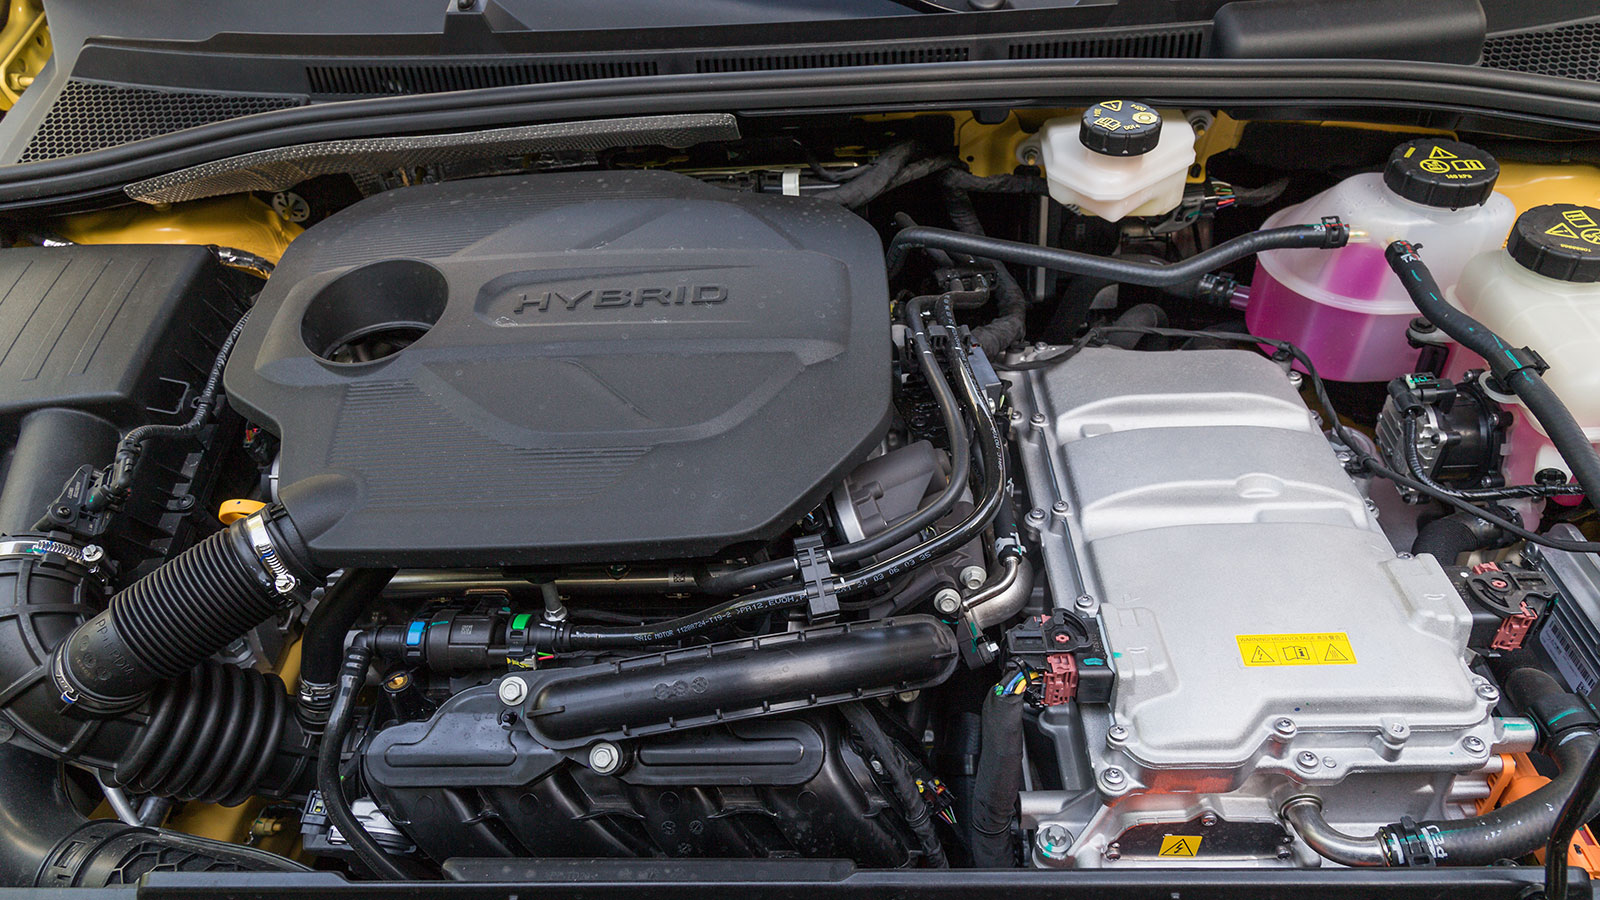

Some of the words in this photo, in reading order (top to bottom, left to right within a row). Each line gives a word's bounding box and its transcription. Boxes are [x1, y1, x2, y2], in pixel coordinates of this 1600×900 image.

[513, 283, 729, 314] HYBRID
[654, 629, 674, 640] MOTOR
[872, 574, 885, 583] 03
[888, 566, 901, 576] 06
